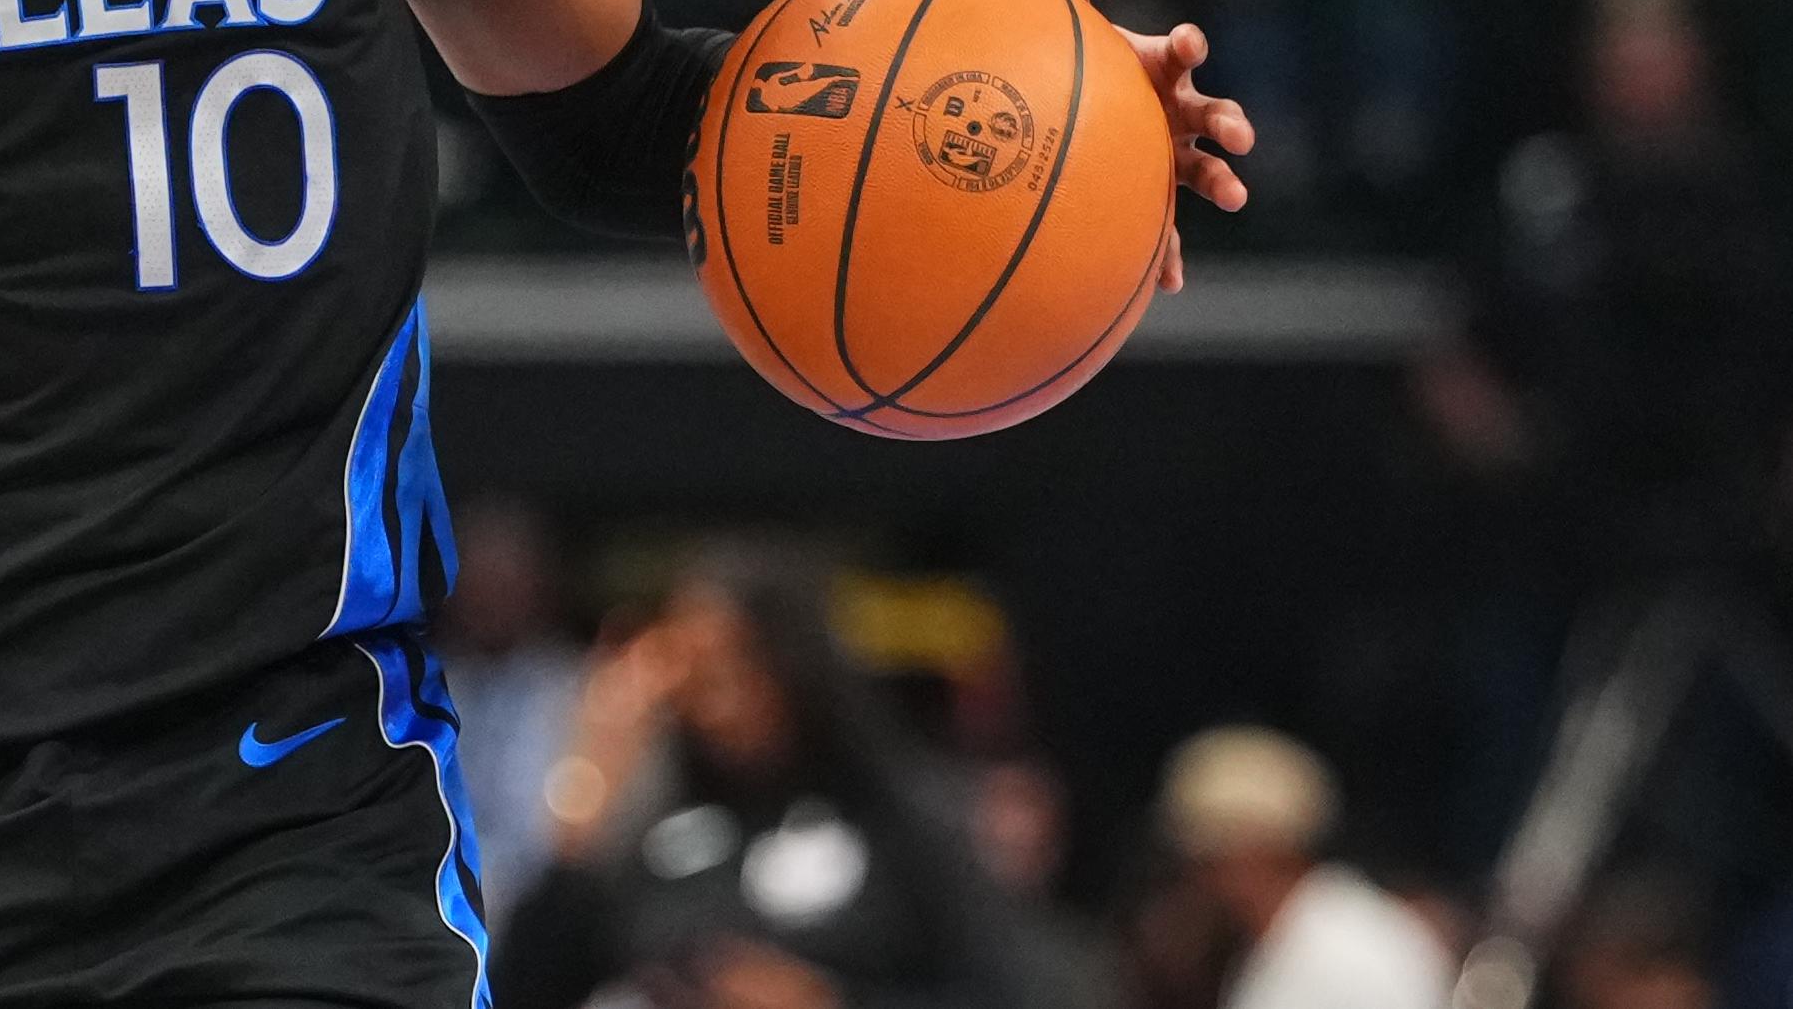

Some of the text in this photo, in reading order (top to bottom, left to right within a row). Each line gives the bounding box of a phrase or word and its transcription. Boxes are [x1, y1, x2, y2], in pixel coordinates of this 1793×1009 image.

[93, 48, 341, 292] 10
[767, 133, 791, 245] OFFICIAL GAME BALL
